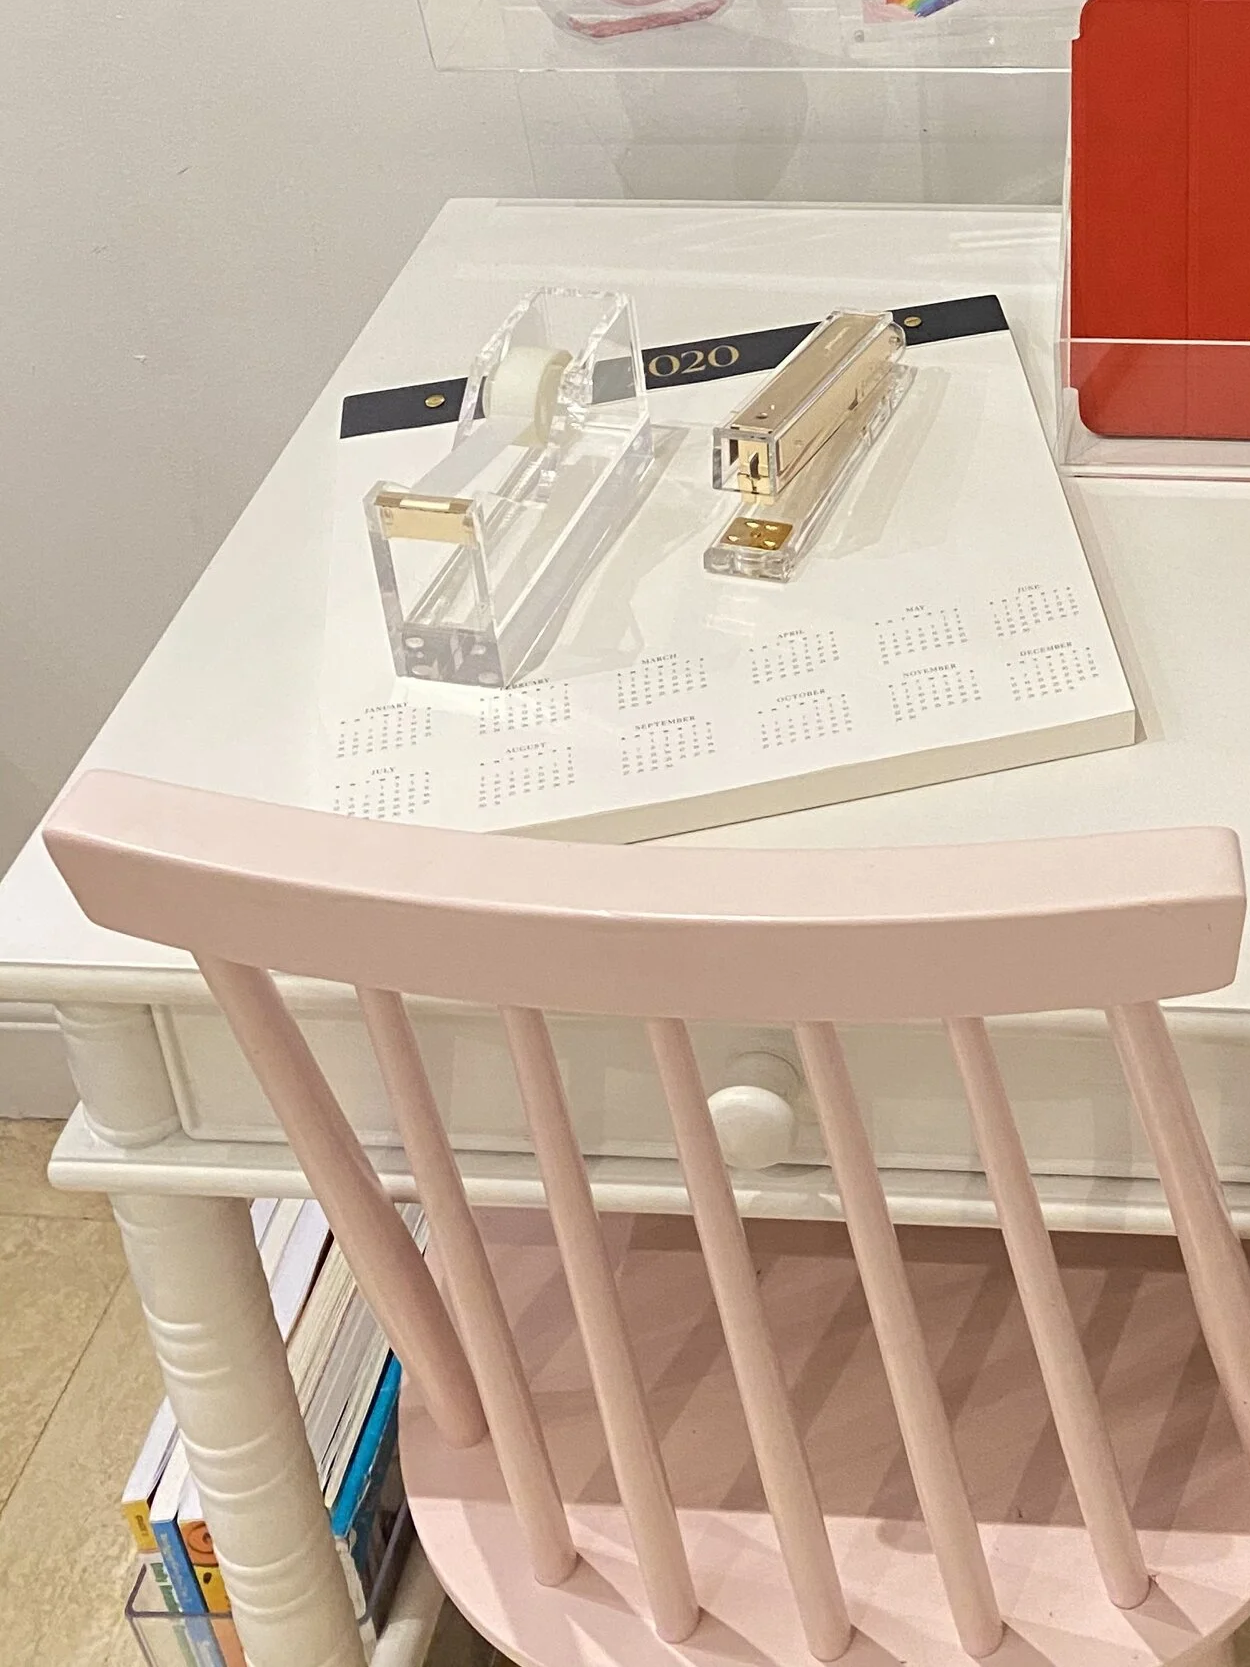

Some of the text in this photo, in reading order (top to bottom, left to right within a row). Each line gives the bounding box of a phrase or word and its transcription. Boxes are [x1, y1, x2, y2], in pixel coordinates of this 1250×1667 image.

[648, 345, 740, 377] 020
[906, 605, 926, 613] MAY
[1019, 641, 1073, 657] DECEMBER
[902, 663, 957, 678] NOVEMBER
[776, 688, 826, 703] OCTOBER
[635, 715, 696, 730] SEPTEMBER
[371, 767, 396, 776] JULY
